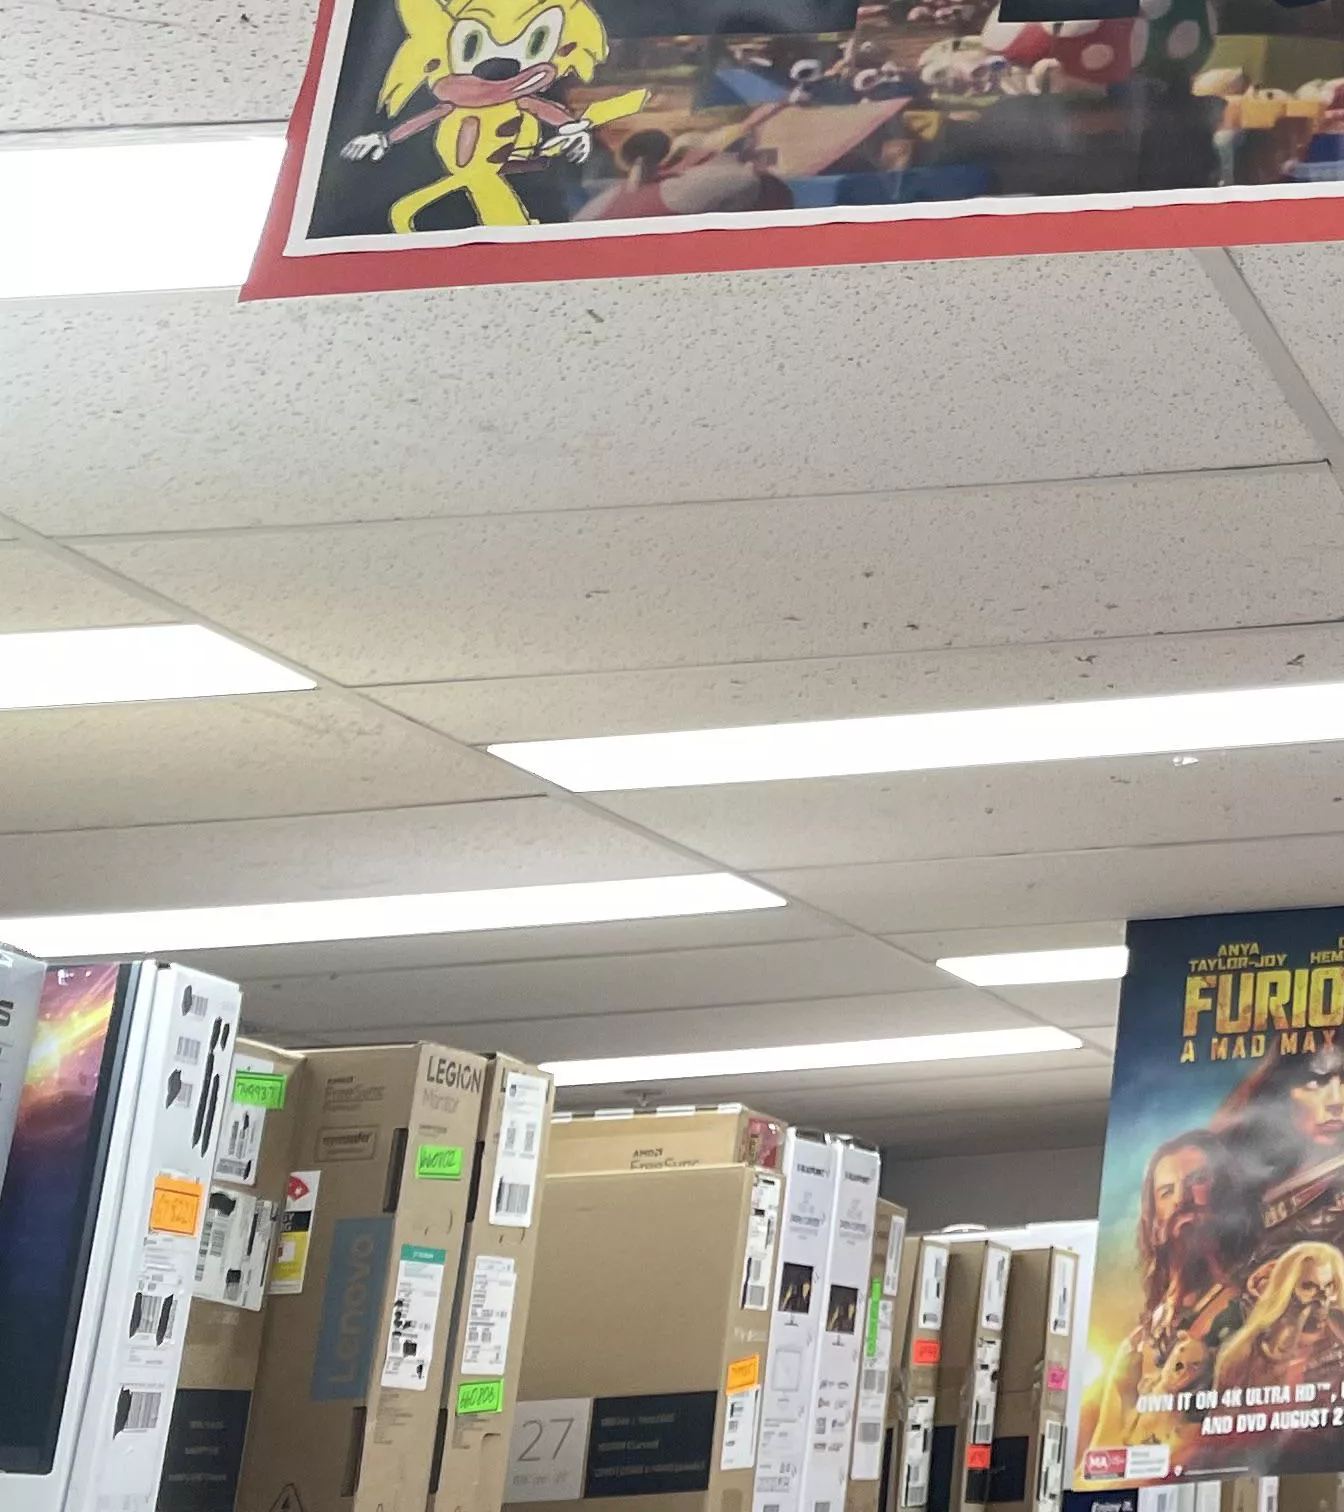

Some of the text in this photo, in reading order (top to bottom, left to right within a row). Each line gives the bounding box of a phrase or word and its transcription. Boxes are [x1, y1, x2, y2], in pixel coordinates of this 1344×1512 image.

[1188, 953, 1289, 972] TAYLOR-JOY
[1217, 942, 1260, 957] ANYA
[1180, 1039, 1196, 1064] A
[1210, 1034, 1267, 1061] MAD
[1279, 1029, 1338, 1056] MAX
[426, 1055, 484, 1094] LEGION
[1136, 1393, 1174, 1414] OWN
[1176, 1392, 1194, 1411] IT
[1195, 1390, 1218, 1410] ON
[1221, 1387, 1242, 1408] 4K
[1244, 1385, 1291, 1407] ULTRA
[1201, 1414, 1233, 1437] AND
[1236, 1413, 1268, 1435] DVD
[1269, 1408, 1330, 1431] AUGUST
[516, 1417, 577, 1463] 27
